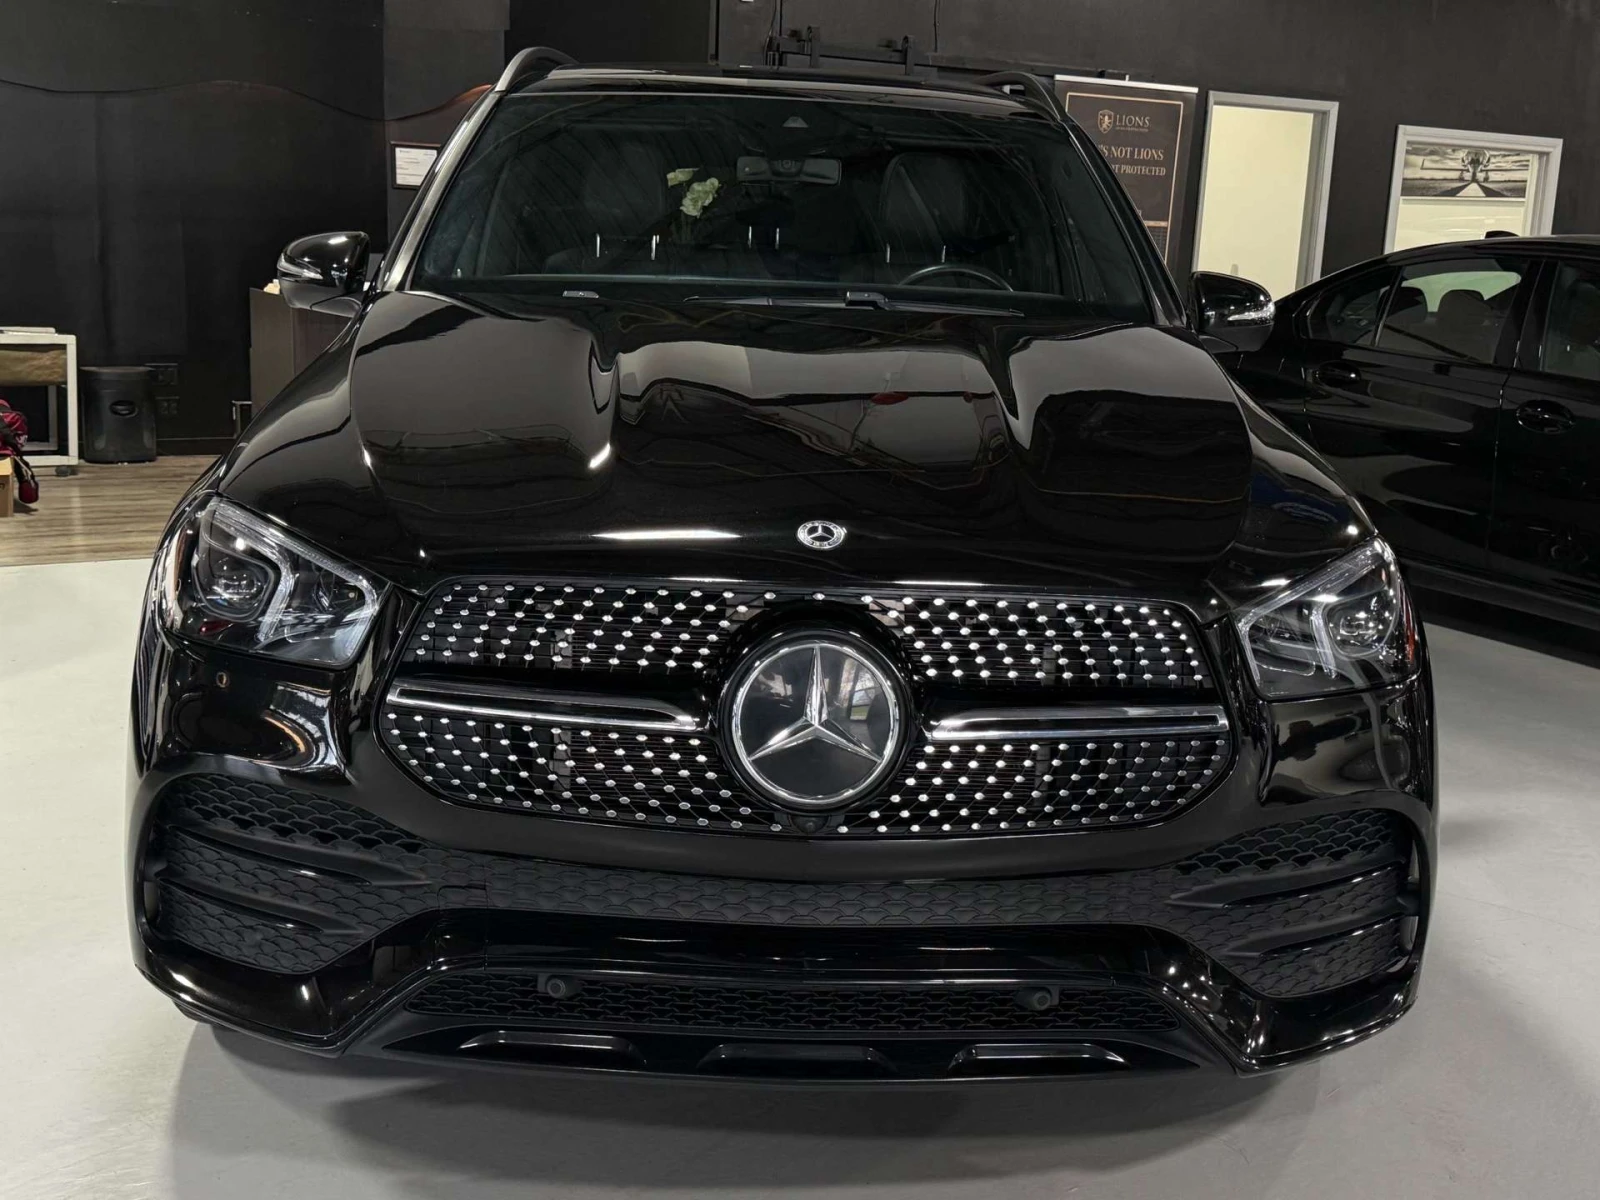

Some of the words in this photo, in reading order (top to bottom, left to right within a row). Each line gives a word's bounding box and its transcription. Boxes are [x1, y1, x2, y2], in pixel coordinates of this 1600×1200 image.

[1116, 114, 1150, 128] LIONS
[1111, 146, 1132, 159] NOT
[1134, 147, 1164, 161] LIONS
[1121, 164, 1166, 176] PROTECTED
